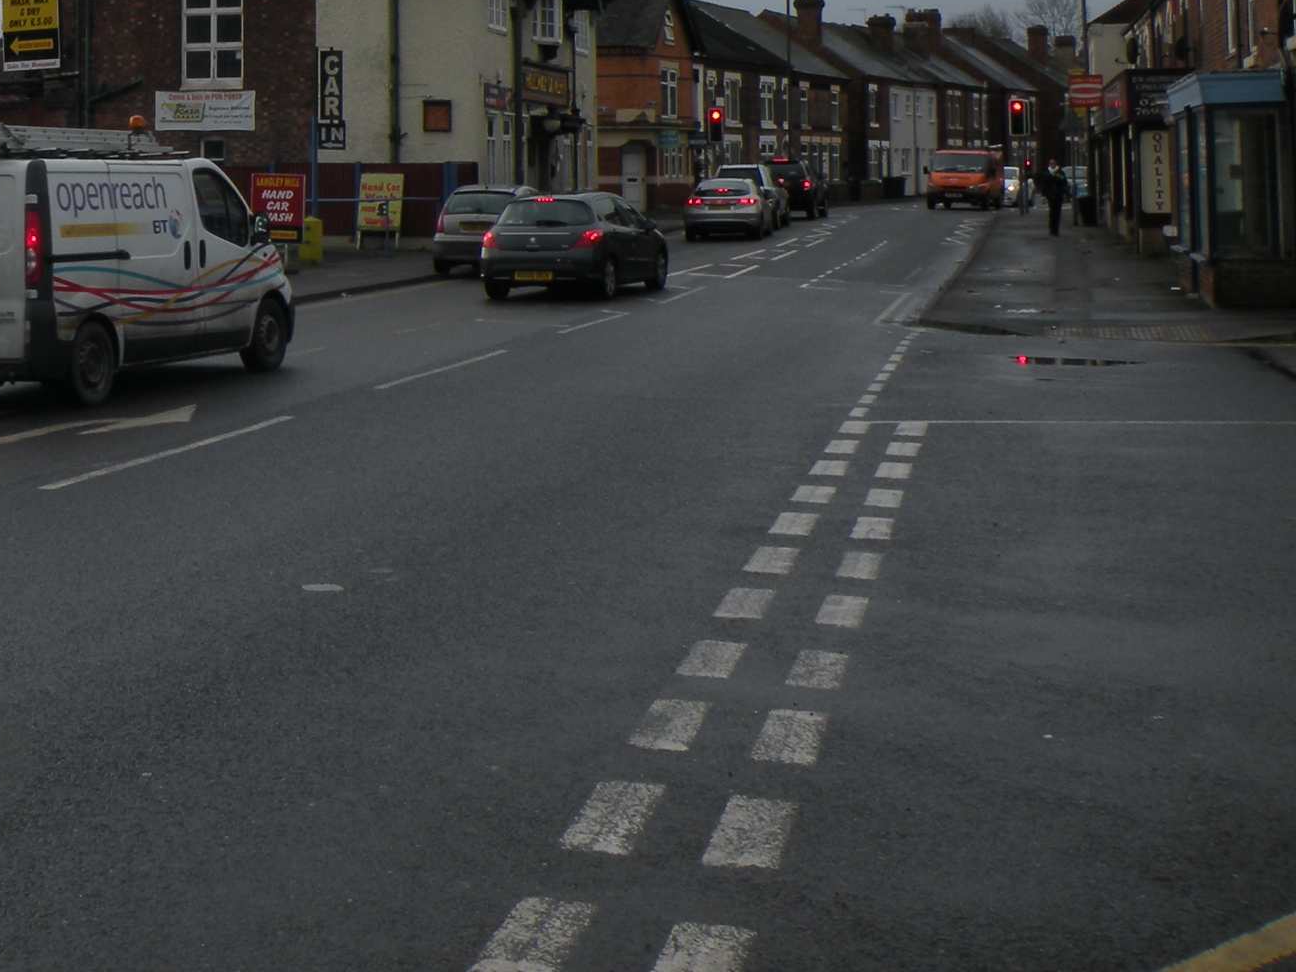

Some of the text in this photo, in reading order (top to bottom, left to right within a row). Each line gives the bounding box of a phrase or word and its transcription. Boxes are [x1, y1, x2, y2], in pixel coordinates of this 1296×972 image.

[26, 7, 41, 16] DRY
[9, 19, 28, 29] ONLY
[324, 55, 340, 116] CAR
[321, 127, 344, 141] IN
[1152, 132, 1164, 210] QUALITY
[256, 177, 300, 187] LANGLEY MILL
[361, 182, 400, 191] Hand Car
[56, 177, 167, 218] openreach
[261, 189, 294, 200] HAND
[266, 200, 290, 212] CAR
[153, 219, 168, 234] BT
